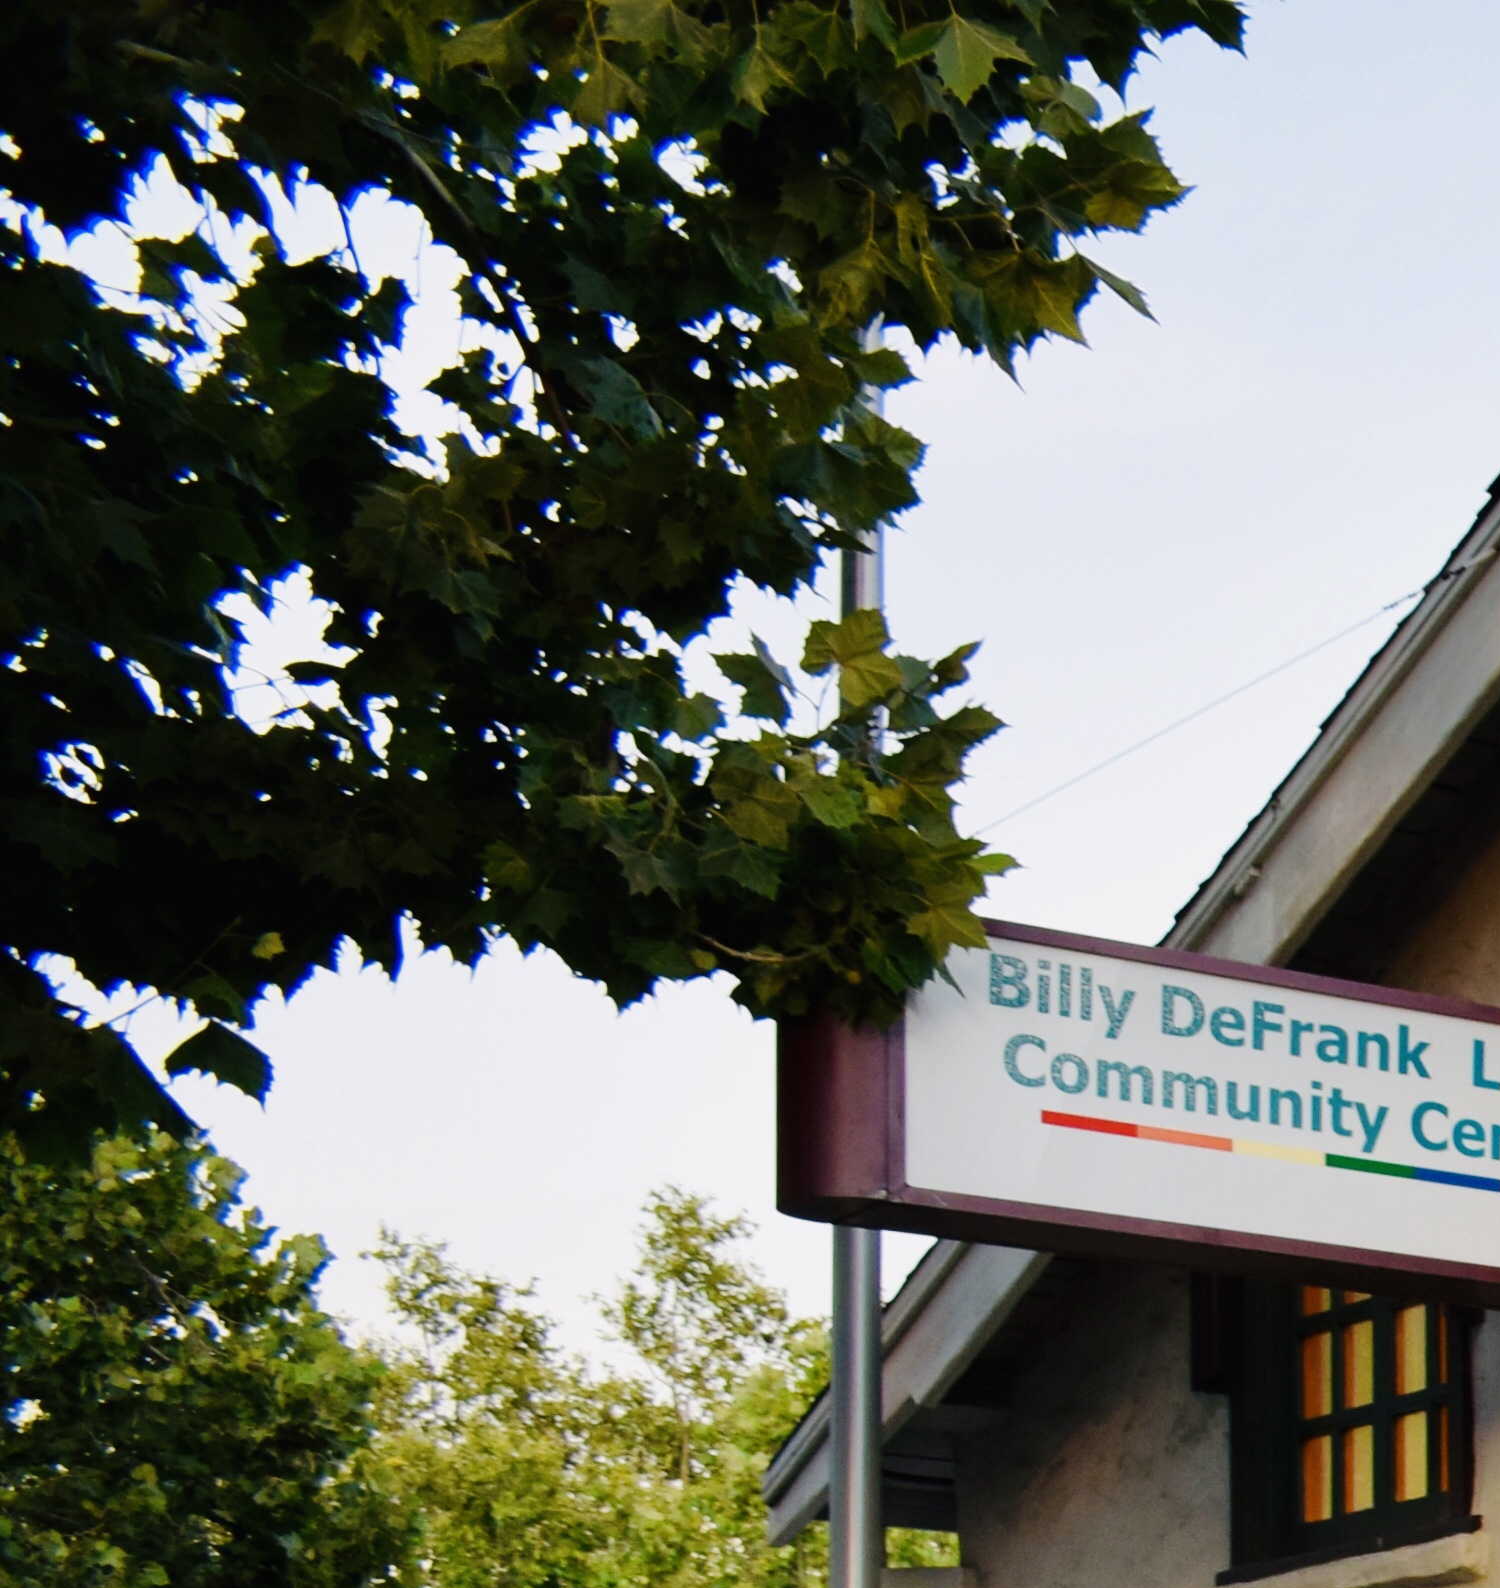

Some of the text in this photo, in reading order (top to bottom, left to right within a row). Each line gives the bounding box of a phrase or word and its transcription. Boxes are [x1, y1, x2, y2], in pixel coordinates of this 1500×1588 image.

[989, 953, 1137, 1040] Billy
[1161, 983, 1433, 1080] DeFrank
[1003, 1033, 1390, 1153] Community
